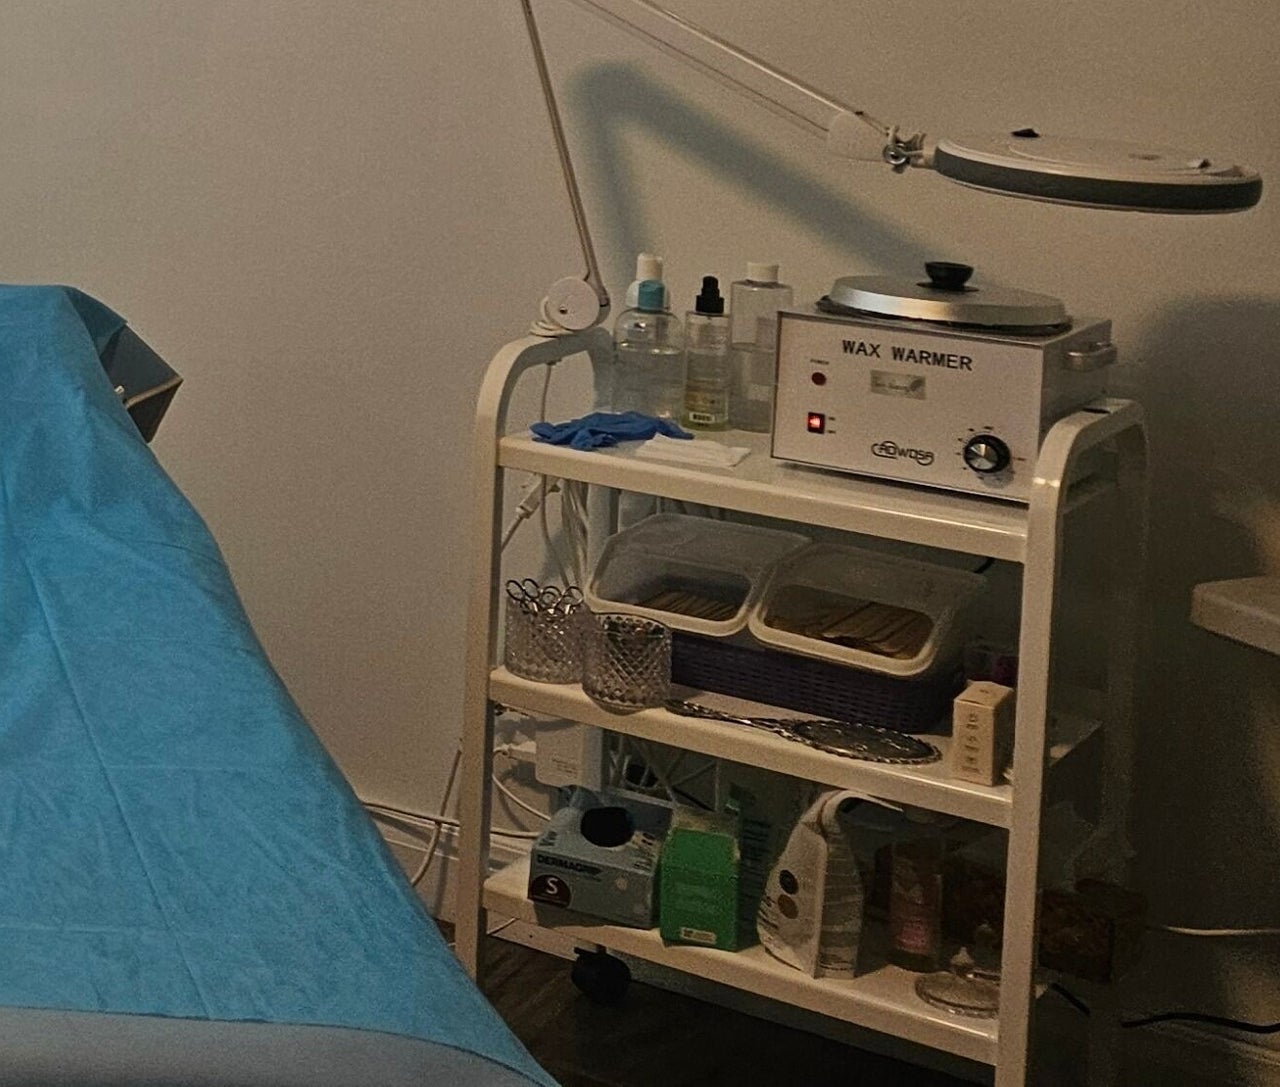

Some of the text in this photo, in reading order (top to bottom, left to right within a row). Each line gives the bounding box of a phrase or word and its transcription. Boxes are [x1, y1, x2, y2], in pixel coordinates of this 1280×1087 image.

[842, 339, 973, 371] WAX WARMER
[545, 877, 559, 895] S
